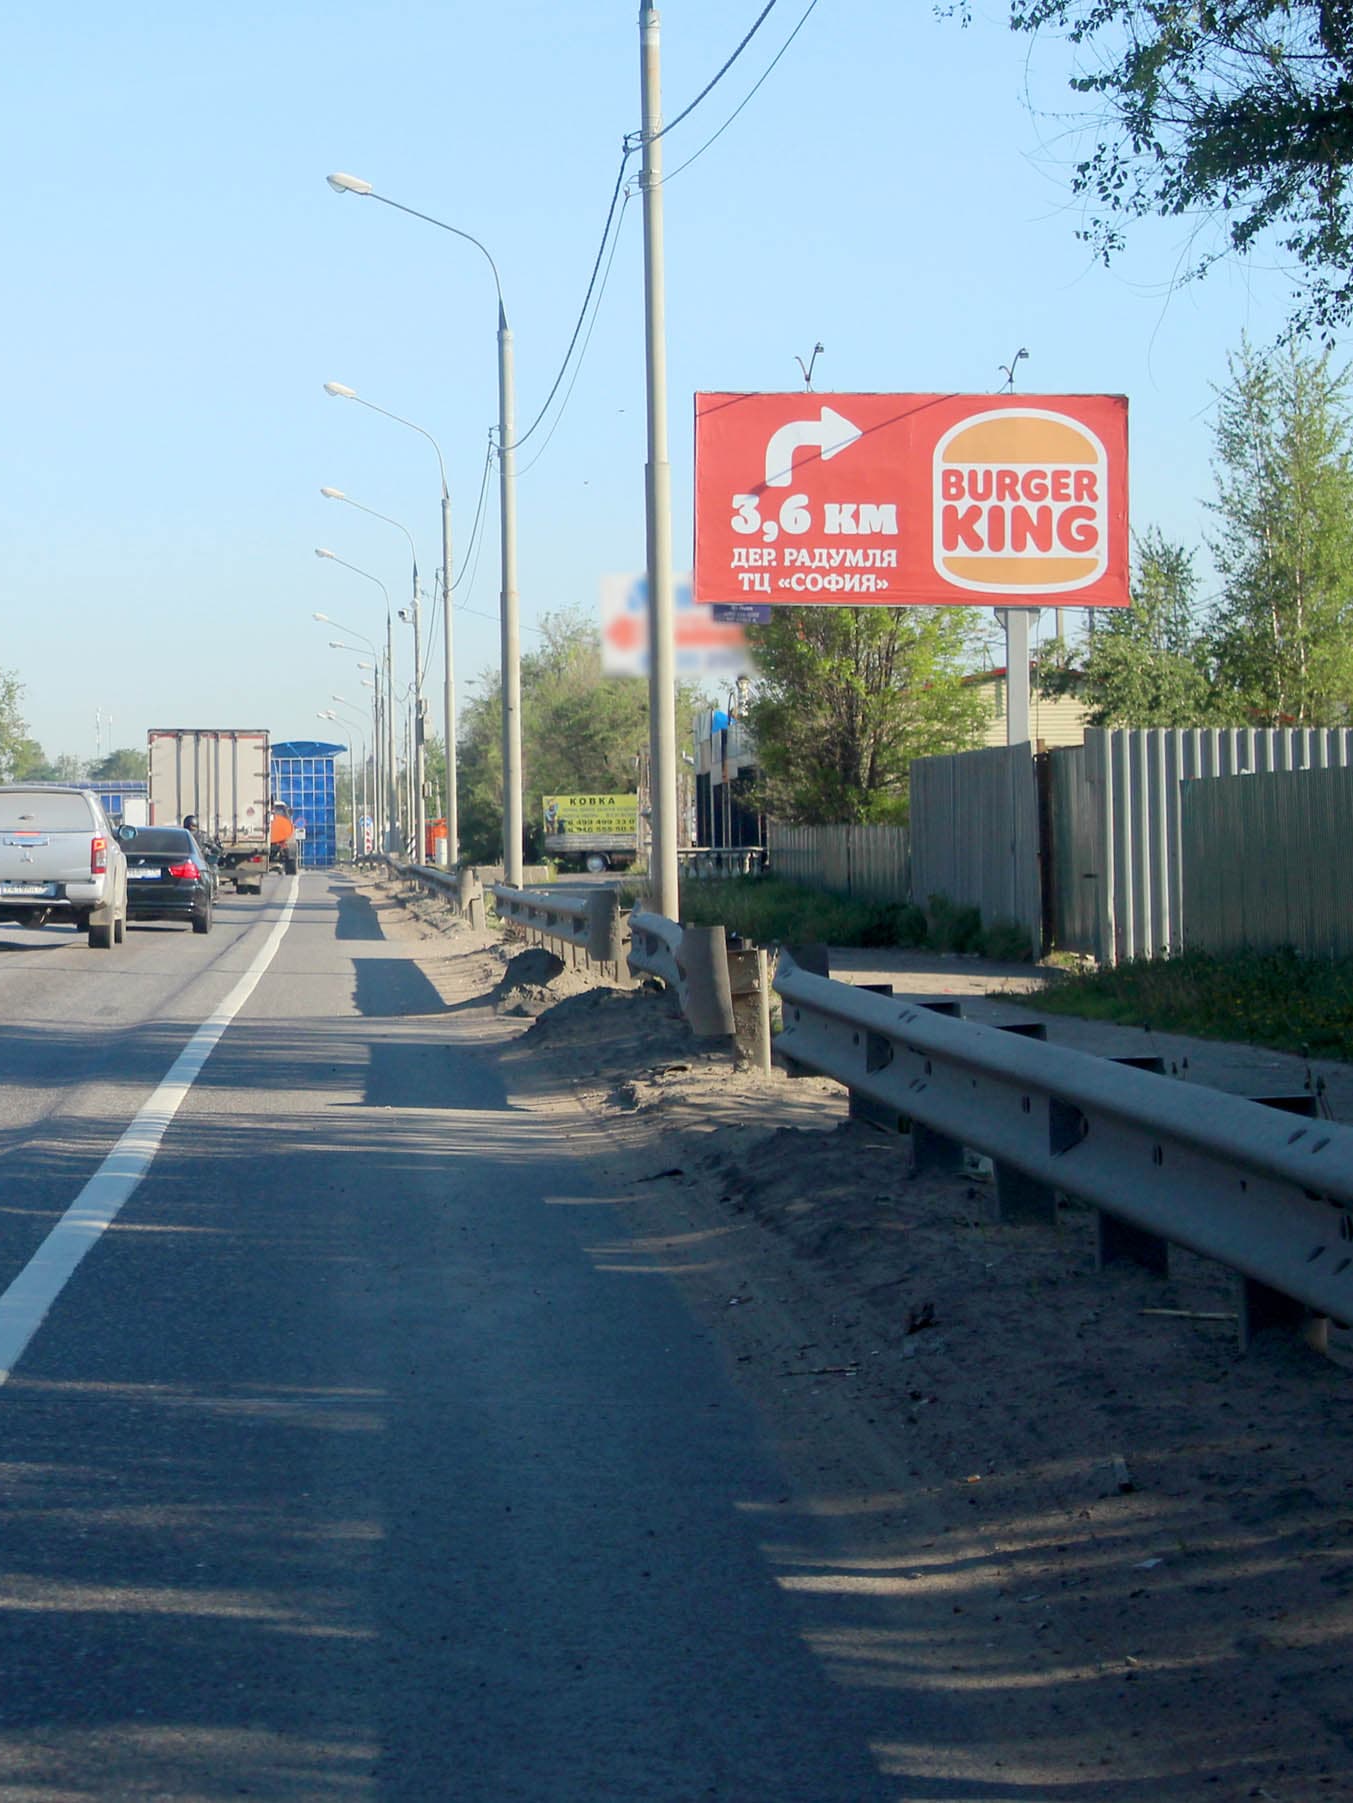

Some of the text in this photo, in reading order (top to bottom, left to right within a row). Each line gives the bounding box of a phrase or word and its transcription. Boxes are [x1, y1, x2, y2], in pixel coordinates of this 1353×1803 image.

[941, 468, 1099, 503] BURGER
[730, 493, 812, 542] 3,6
[941, 505, 1100, 553] KING
[730, 548, 898, 569] ДЕР. РАДУМЛЯ
[738, 573, 889, 594] ТЦ «СОФИЯ»
[569, 797, 616, 806] КОВКА
